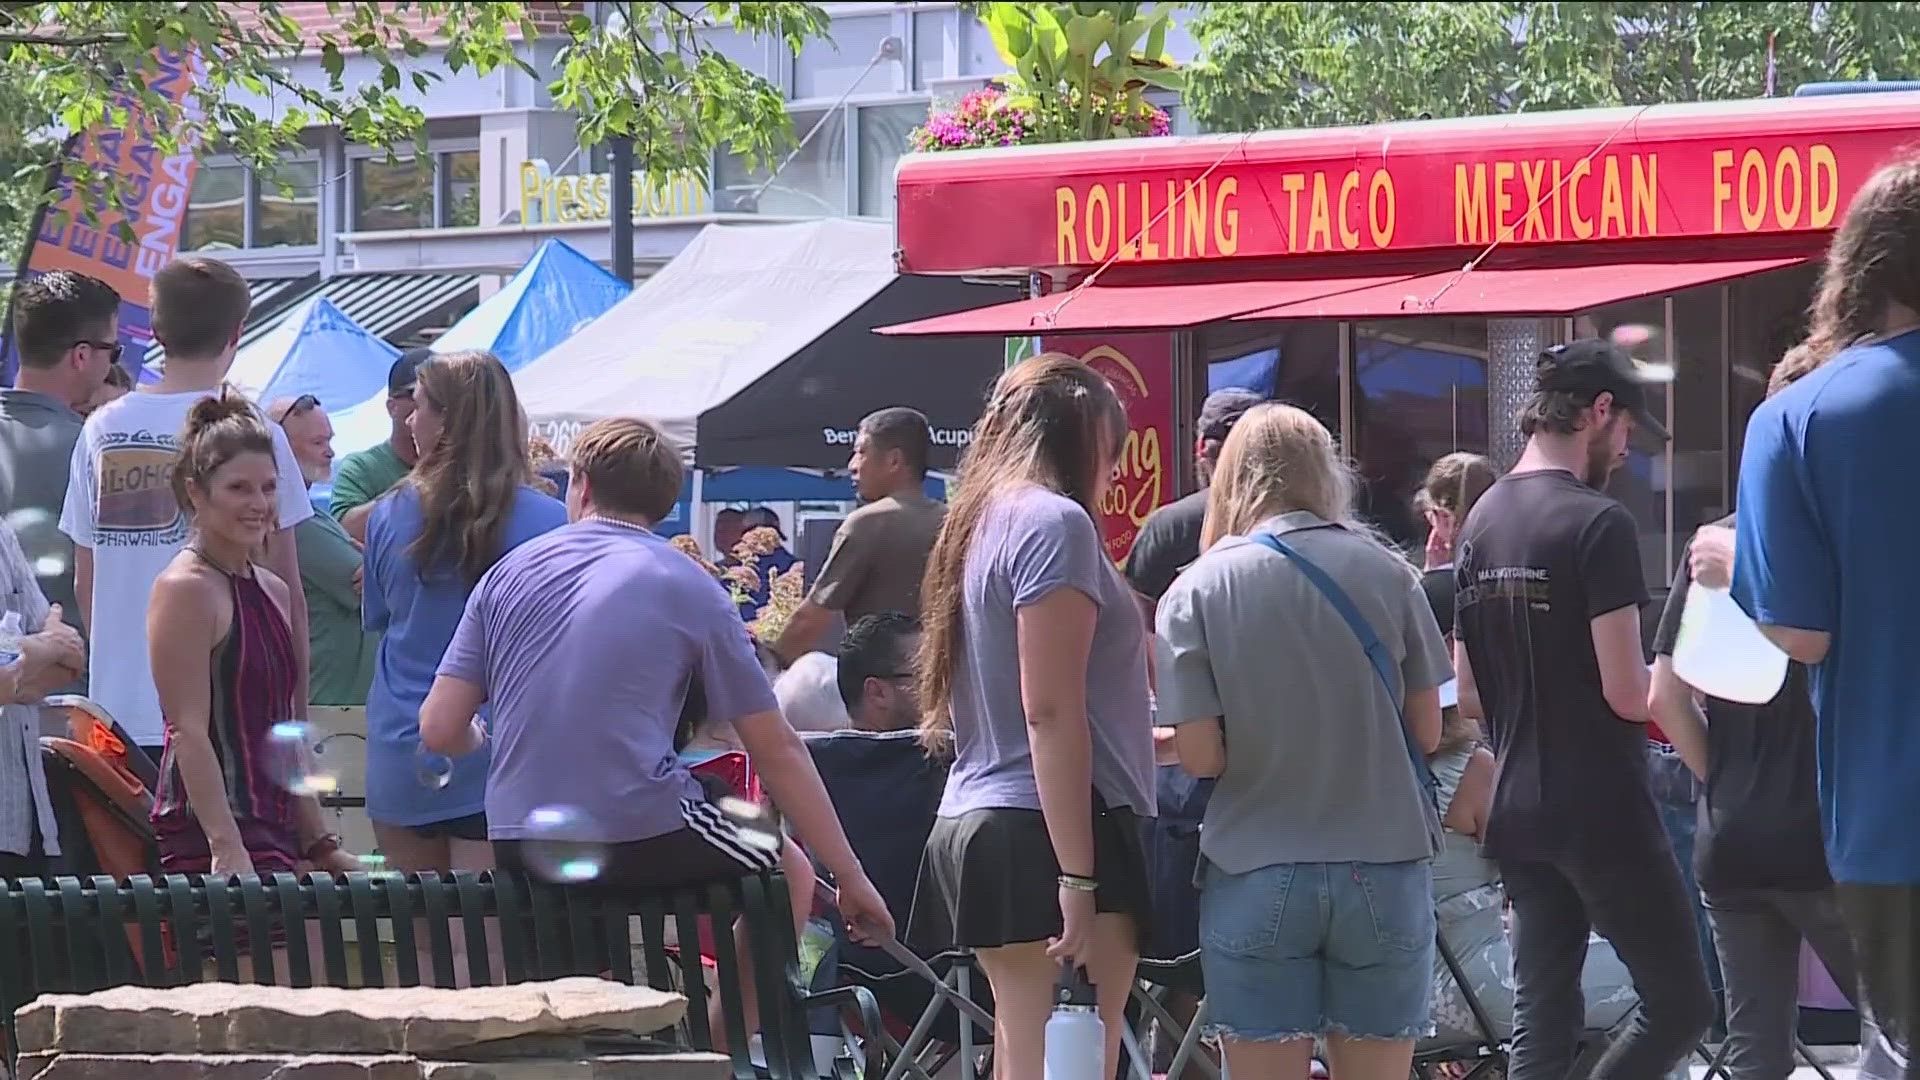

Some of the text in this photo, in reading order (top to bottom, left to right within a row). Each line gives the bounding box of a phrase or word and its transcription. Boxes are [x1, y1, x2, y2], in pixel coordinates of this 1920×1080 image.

[520, 161, 704, 228] Pressoom
[1055, 143, 1839, 266] ROLLING TACO MEXICAN FOOD
[107, 533, 159, 547] HAWAII
